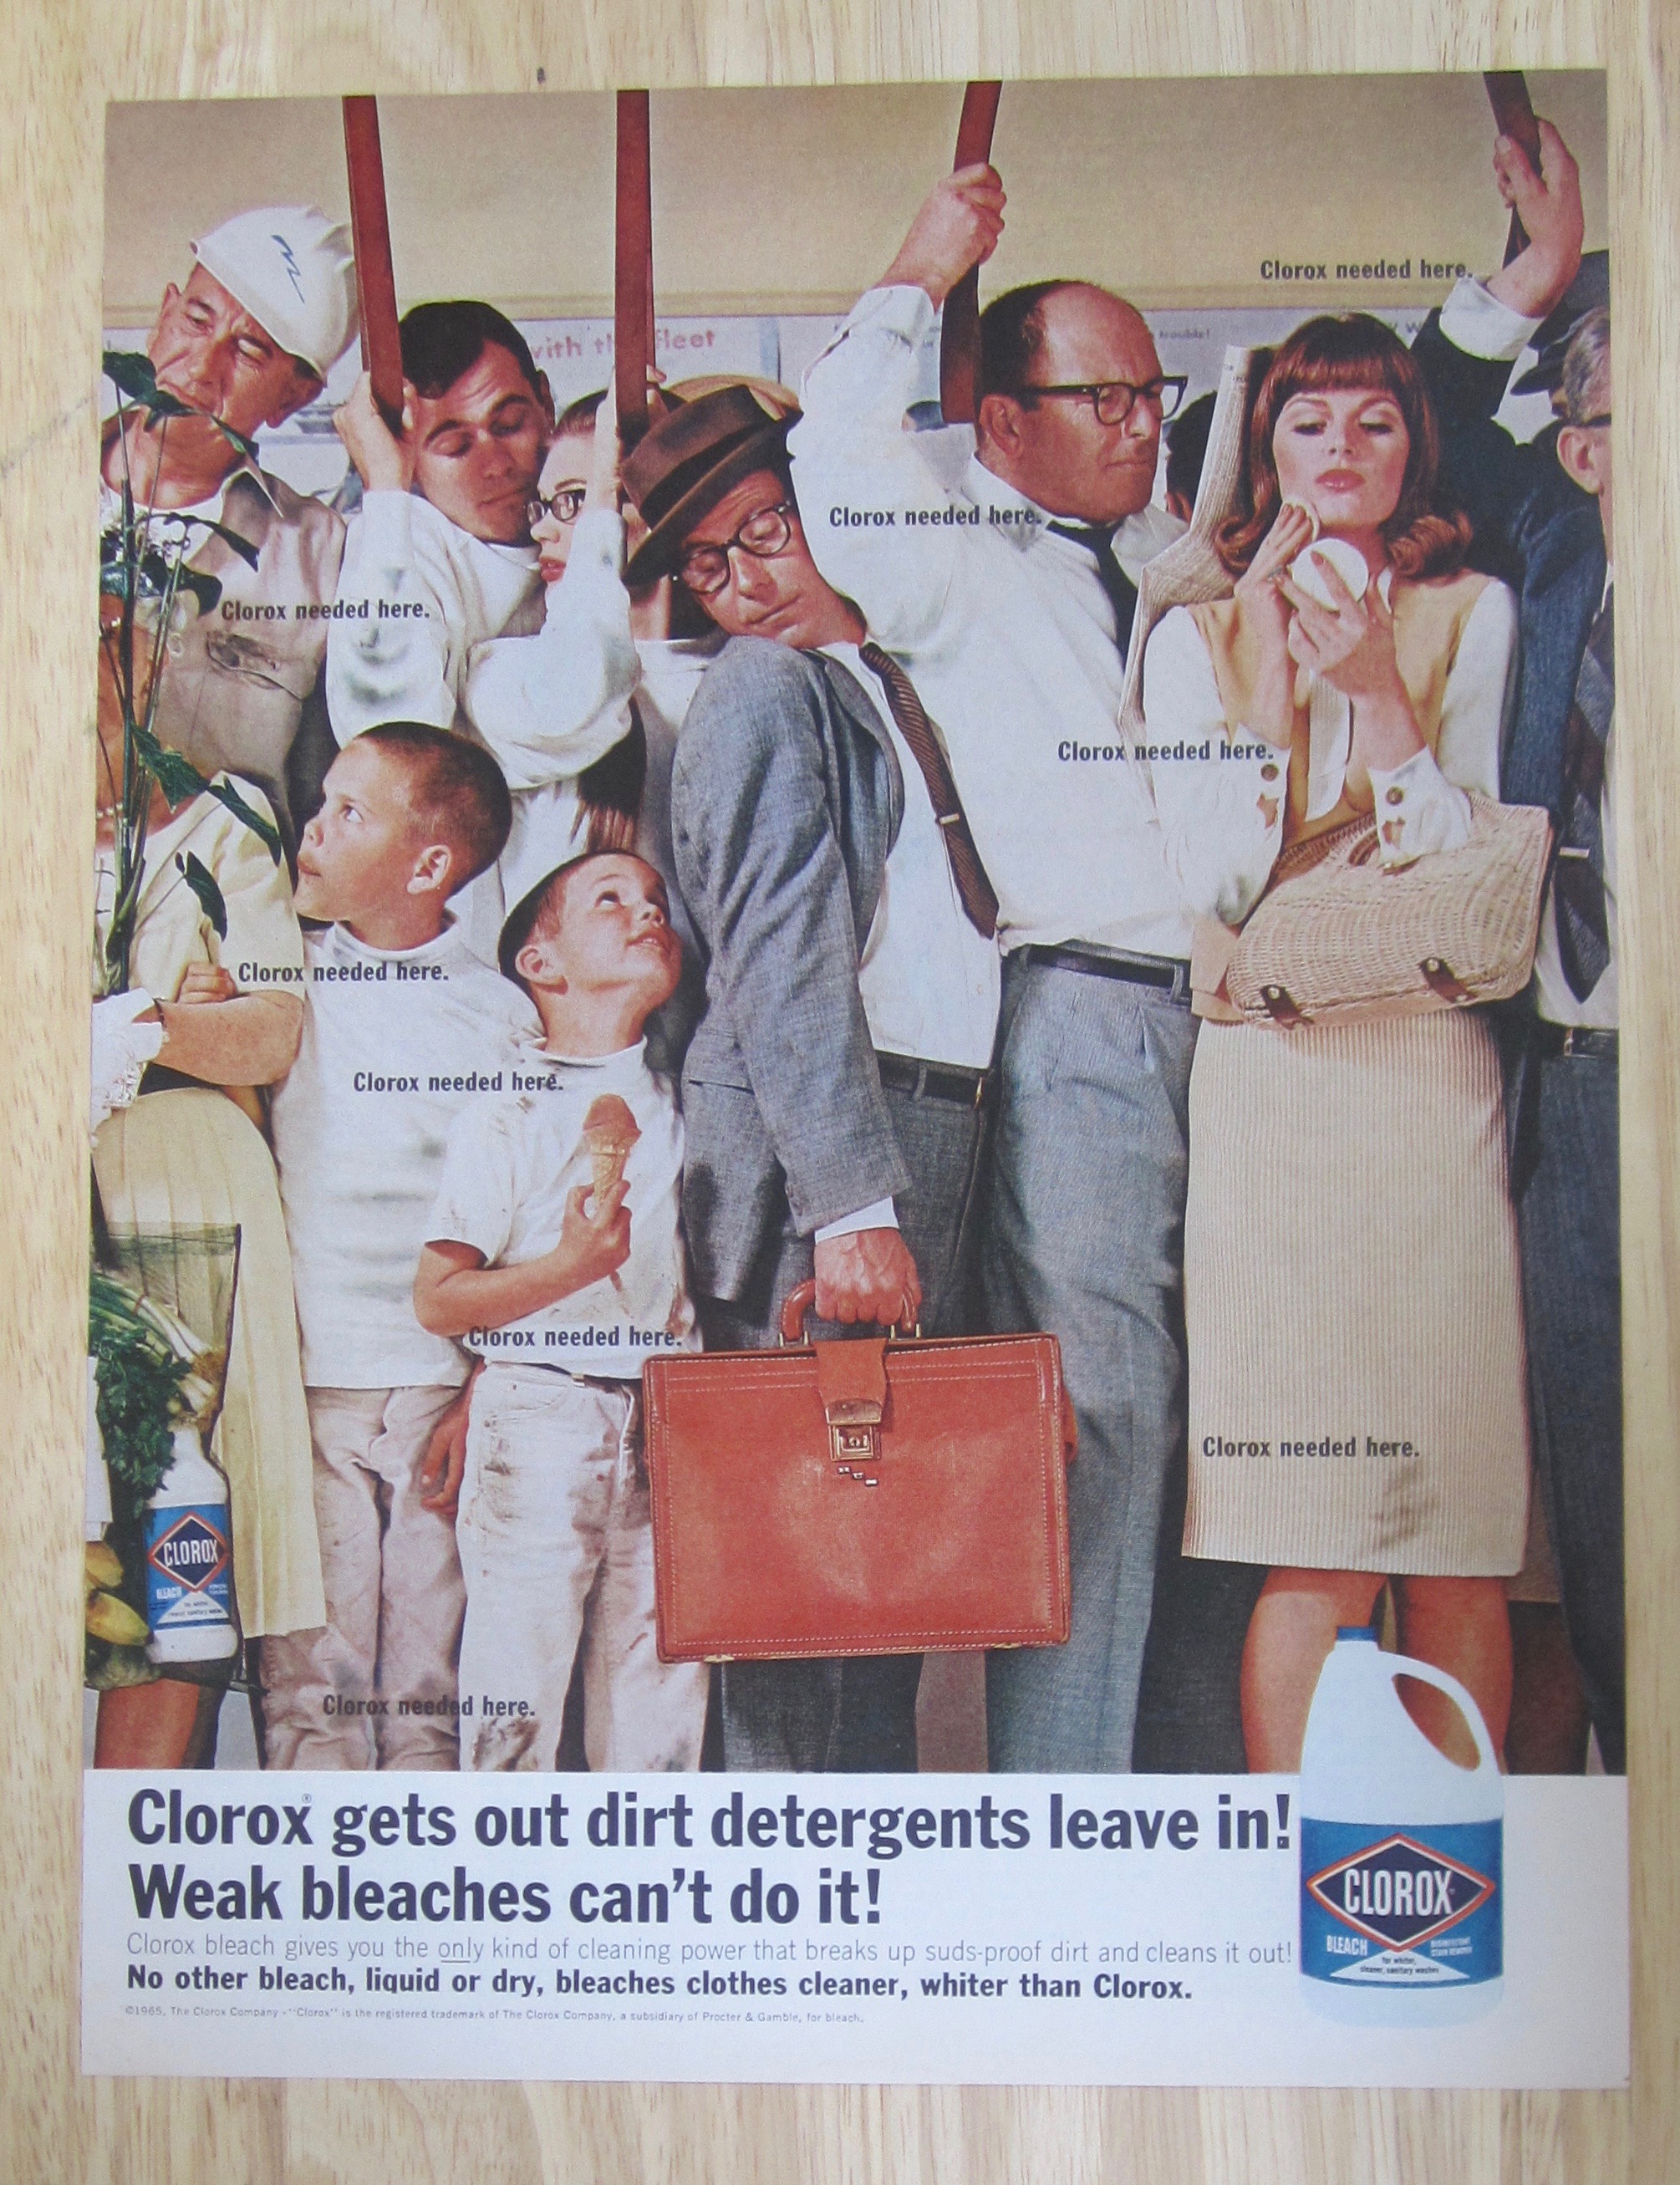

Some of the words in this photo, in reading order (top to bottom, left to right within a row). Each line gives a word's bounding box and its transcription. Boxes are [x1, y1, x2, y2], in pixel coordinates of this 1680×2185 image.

[1260, 260, 1327, 280] Clorox
[1336, 259, 1411, 279] needed
[1421, 258, 1473, 278] here.
[830, 507, 895, 527] Clorox
[905, 505, 980, 526] needed
[988, 504, 1042, 525] here.
[221, 600, 287, 621] Clorox
[296, 599, 369, 619] needed
[378, 598, 430, 619] here.
[1058, 741, 1126, 761] Clorox
[1135, 740, 1210, 761] needed
[1220, 740, 1274, 759] here.
[238, 962, 304, 982] Clorox
[313, 961, 387, 981] needed
[396, 960, 449, 980] here.
[354, 1072, 419, 1092] Clorox
[429, 1072, 502, 1092] needed
[512, 1071, 564, 1091] here.
[469, 1326, 535, 1347] Clorox
[545, 1326, 619, 1346] needed
[629, 1325, 682, 1346] here.
[1203, 1436, 1270, 1457] Clorox
[1280, 1436, 1356, 1457] needed
[1367, 1436, 1420, 1457] here.
[164, 1539, 217, 1566] CLOROX
[323, 1694, 389, 1714] Clorox
[398, 1695, 473, 1716] needed
[482, 1695, 536, 1716] here.
[332, 1793, 456, 1857] gets
[475, 1794, 569, 1846] out
[587, 1791, 693, 1847] dirt
[711, 1792, 1031, 1860] detergents
[1050, 1793, 1199, 1850] leave
[1218, 1794, 1291, 1850] in!
[129, 1864, 283, 1920] Weak
[303, 1865, 551, 1923] bleaches
[569, 1868, 712, 1923] can't
[731, 1867, 799, 1924] do
[819, 1868, 882, 1924] it!
[1344, 1869, 1453, 1916] CLOROX
[127, 1932, 195, 1955] Clorox
[206, 1933, 275, 1957] bleach
[285, 1935, 339, 1961] gives
[347, 1940, 384, 1962] you
[395, 1936, 428, 1958] the
[438, 1937, 482, 1963] only
[492, 1937, 537, 1959] kind
[547, 1937, 570, 1960] of
[578, 1938, 672, 1965] cleaning
[680, 1944, 746, 1965] power
[753, 1938, 797, 1961] that
[806, 1938, 878, 1962] breaks
[888, 1945, 916, 1968] up
[925, 1939, 1042, 1968] suds-proof
[1051, 1939, 1090, 1963] dirt
[1097, 1940, 1139, 1963] and
[1146, 1940, 1218, 1963] cleans
[1225, 1940, 1240, 1964] it
[1249, 1941, 1292, 1964] out!
[1326, 1935, 1368, 1956] BLEACH
[128, 1964, 163, 1989] No
[175, 1965, 248, 1990] other
[259, 1966, 354, 1994] bleach,
[366, 1967, 440, 1994] liquid
[452, 1973, 481, 1994] or
[492, 1969, 544, 1997] dry,
[557, 1969, 675, 1995] bleaches
[687, 1970, 787, 1996] clothes
[799, 1971, 909, 2001] cleaner,
[920, 1972, 1011, 1998] whiter
[1020, 1973, 1082, 1998] than
[1093, 1974, 1193, 1999] Clorox.
[171, 2006, 190, 2016] The
[193, 2006, 227, 2017] Clorox
[230, 2006, 279, 2019] Company
[342, 2008, 352, 2018] is
[354, 2008, 372, 2018] the
[375, 2008, 428, 2020] registered
[430, 2009, 486, 2019] trademark
[488, 2009, 499, 2019] of
[503, 2009, 522, 2019] The
[526, 2009, 559, 2020] Clorox
[563, 2009, 616, 2023] Company,
[629, 2010, 685, 2024] subsidiary
[687, 2011, 699, 2021] of
[702, 2011, 741, 2022] Procter
[745, 2012, 754, 2021] &
[757, 2012, 802, 2024] Gamble,
[807, 2012, 822, 2022] for
[825, 2012, 865, 2023] bleach.
